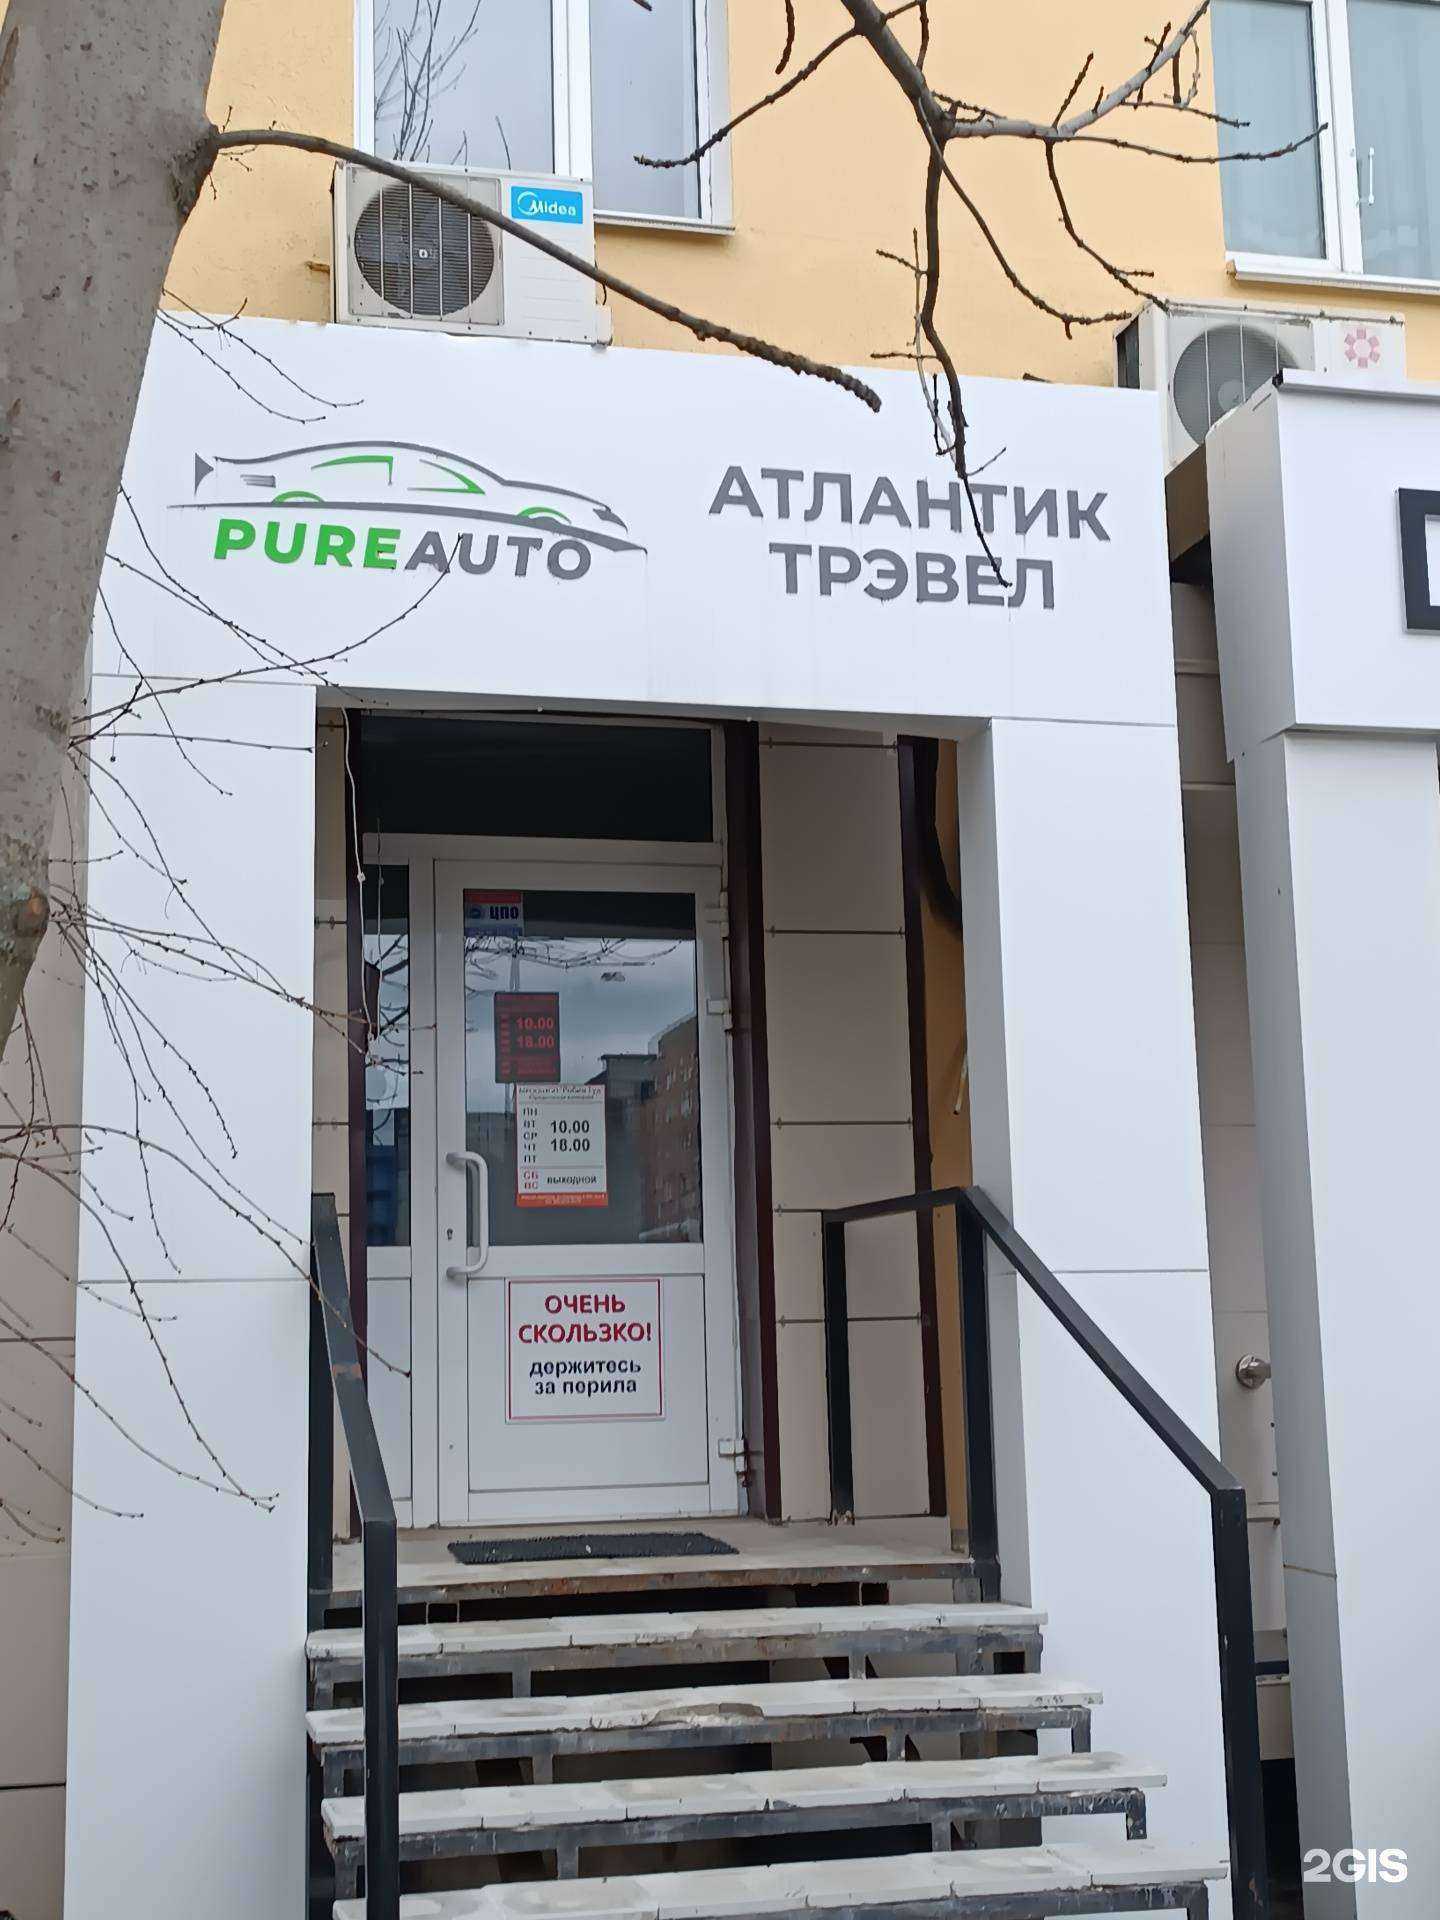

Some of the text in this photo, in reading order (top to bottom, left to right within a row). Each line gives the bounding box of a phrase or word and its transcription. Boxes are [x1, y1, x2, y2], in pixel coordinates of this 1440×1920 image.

[522, 196, 577, 216] Midea
[709, 465, 1111, 542] АТЛАНТИК
[768, 542, 1055, 611] ТРЭВЕЛ
[550, 1120, 590, 1134] 10.00
[550, 1138, 590, 1152] 18.00
[544, 1294, 626, 1315] ОЧЕНЬ
[517, 1322, 653, 1344] СКОЛЬЗКО!
[528, 1359, 642, 1378] держитесь
[534, 1378, 637, 1398] за перила
